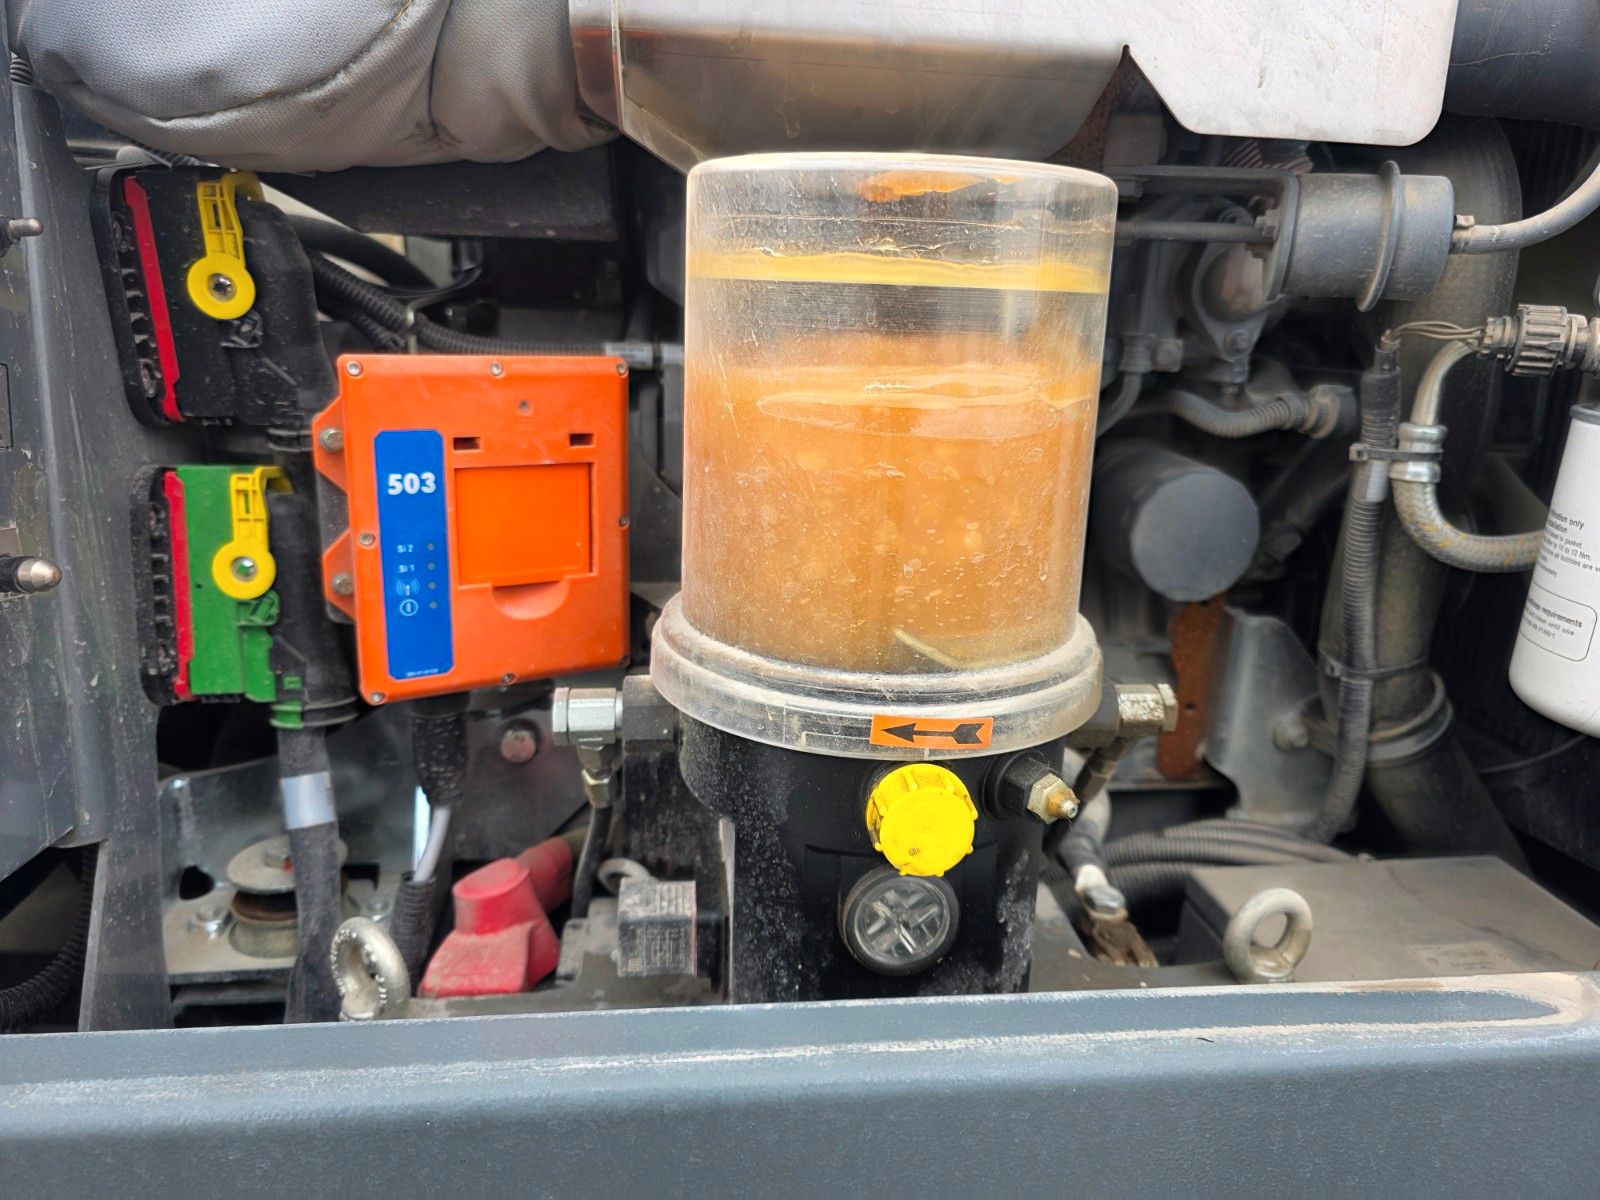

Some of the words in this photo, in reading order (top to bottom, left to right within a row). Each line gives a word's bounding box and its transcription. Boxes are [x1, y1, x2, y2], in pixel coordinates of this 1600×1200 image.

[387, 472, 437, 496] 503
[1568, 519, 1585, 530] only
[408, 544, 414, 553] 2
[1582, 562, 1593, 570] are
[1541, 607, 1582, 628] requirements
[1561, 627, 1575, 636] use
